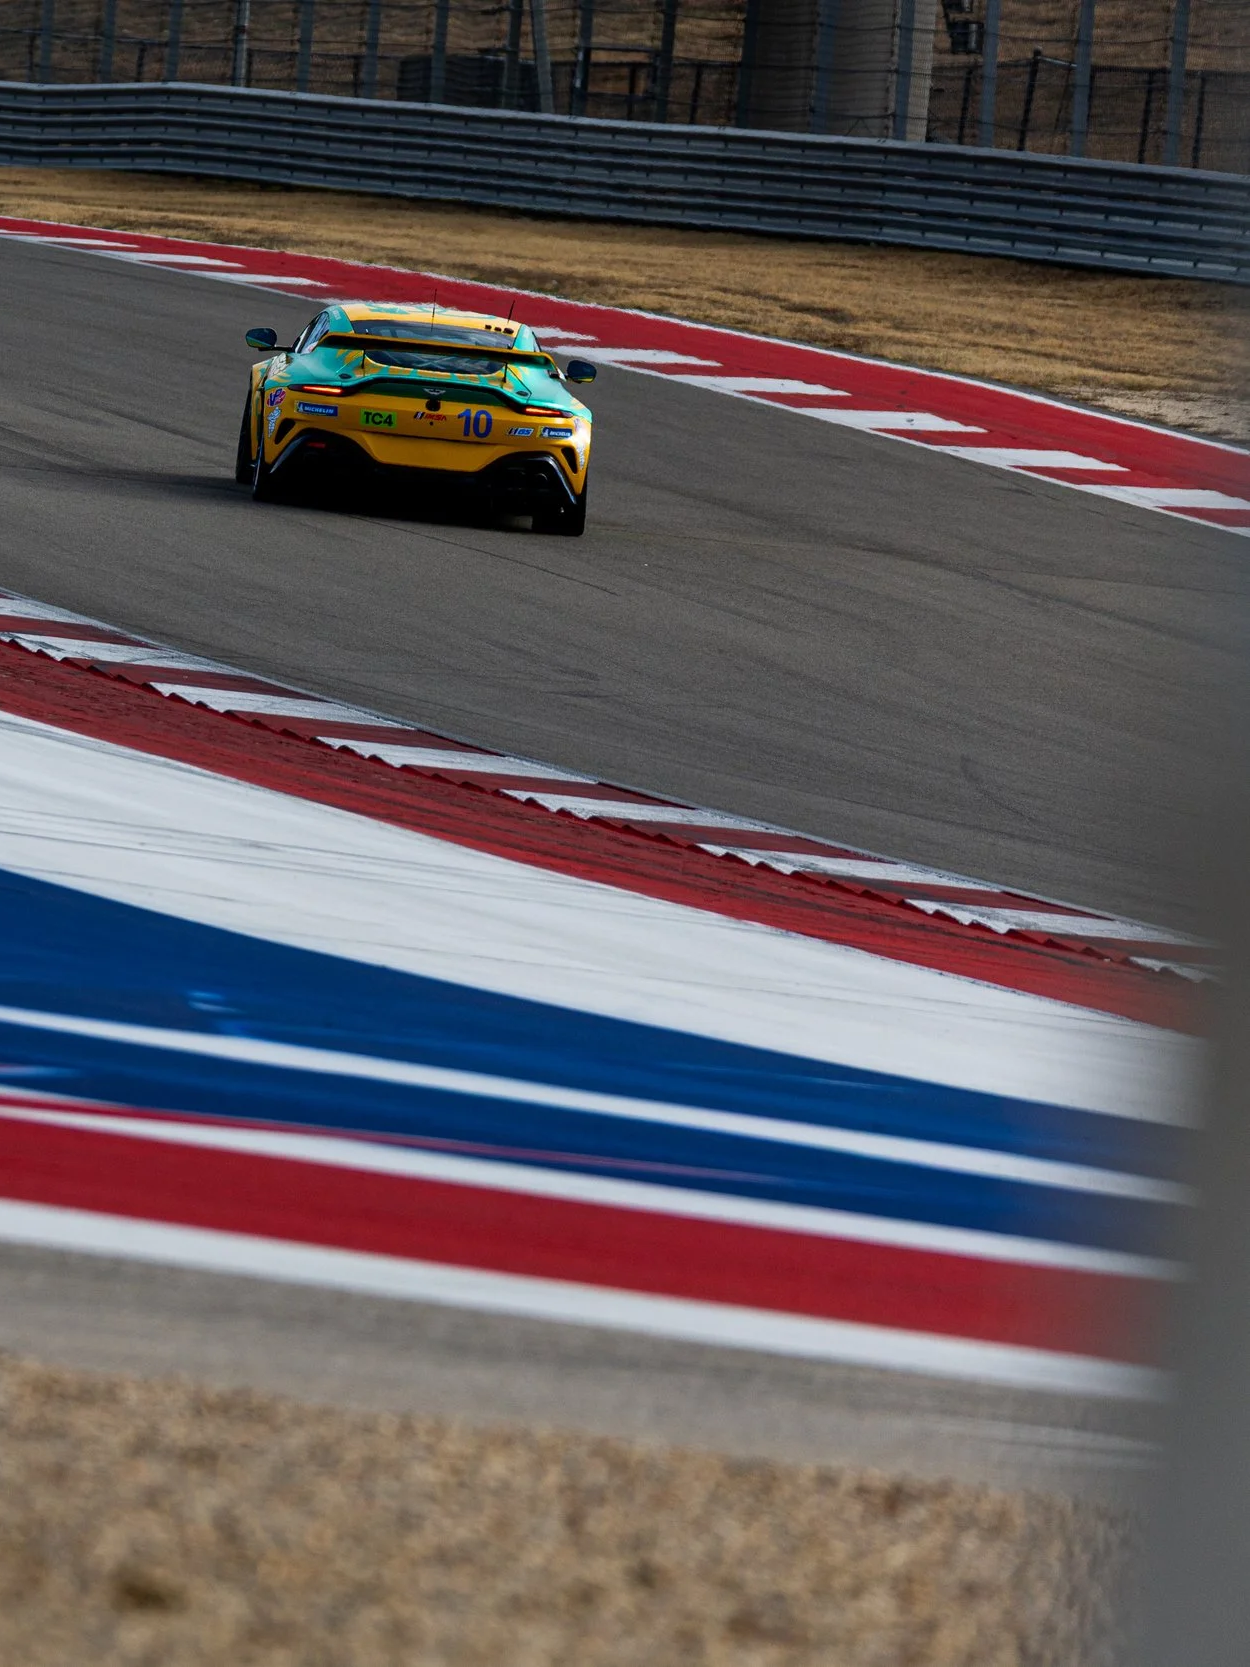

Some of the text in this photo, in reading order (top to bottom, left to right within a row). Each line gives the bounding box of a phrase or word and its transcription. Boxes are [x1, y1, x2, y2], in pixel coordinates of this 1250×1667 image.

[304, 405, 335, 414] MICHELIN
[364, 411, 393, 426] TC4
[457, 408, 493, 438] 10
